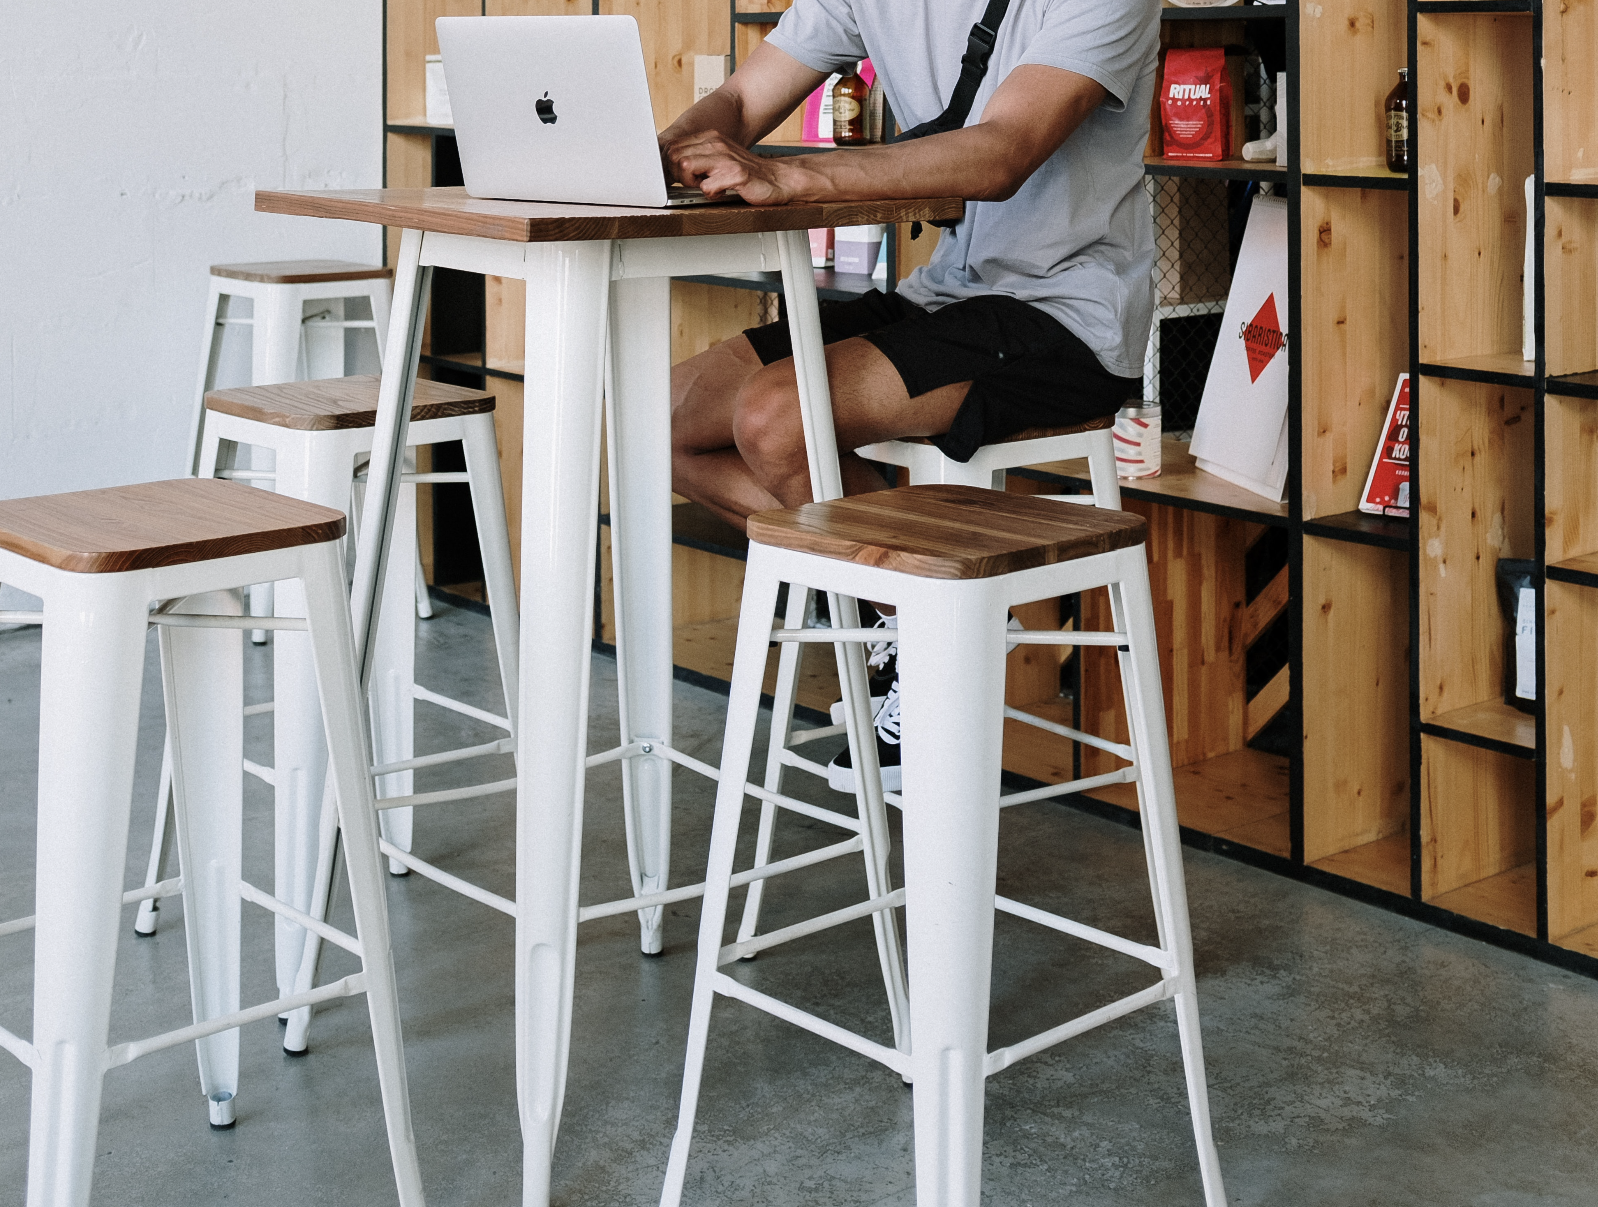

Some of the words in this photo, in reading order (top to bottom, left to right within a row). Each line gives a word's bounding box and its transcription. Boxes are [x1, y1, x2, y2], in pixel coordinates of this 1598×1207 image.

[1168, 83, 1211, 100] RITUAL
[1238, 321, 1289, 353] SIBARISTICA
[1395, 410, 1409, 426] ЧТ
[1391, 443, 1409, 459] КО
